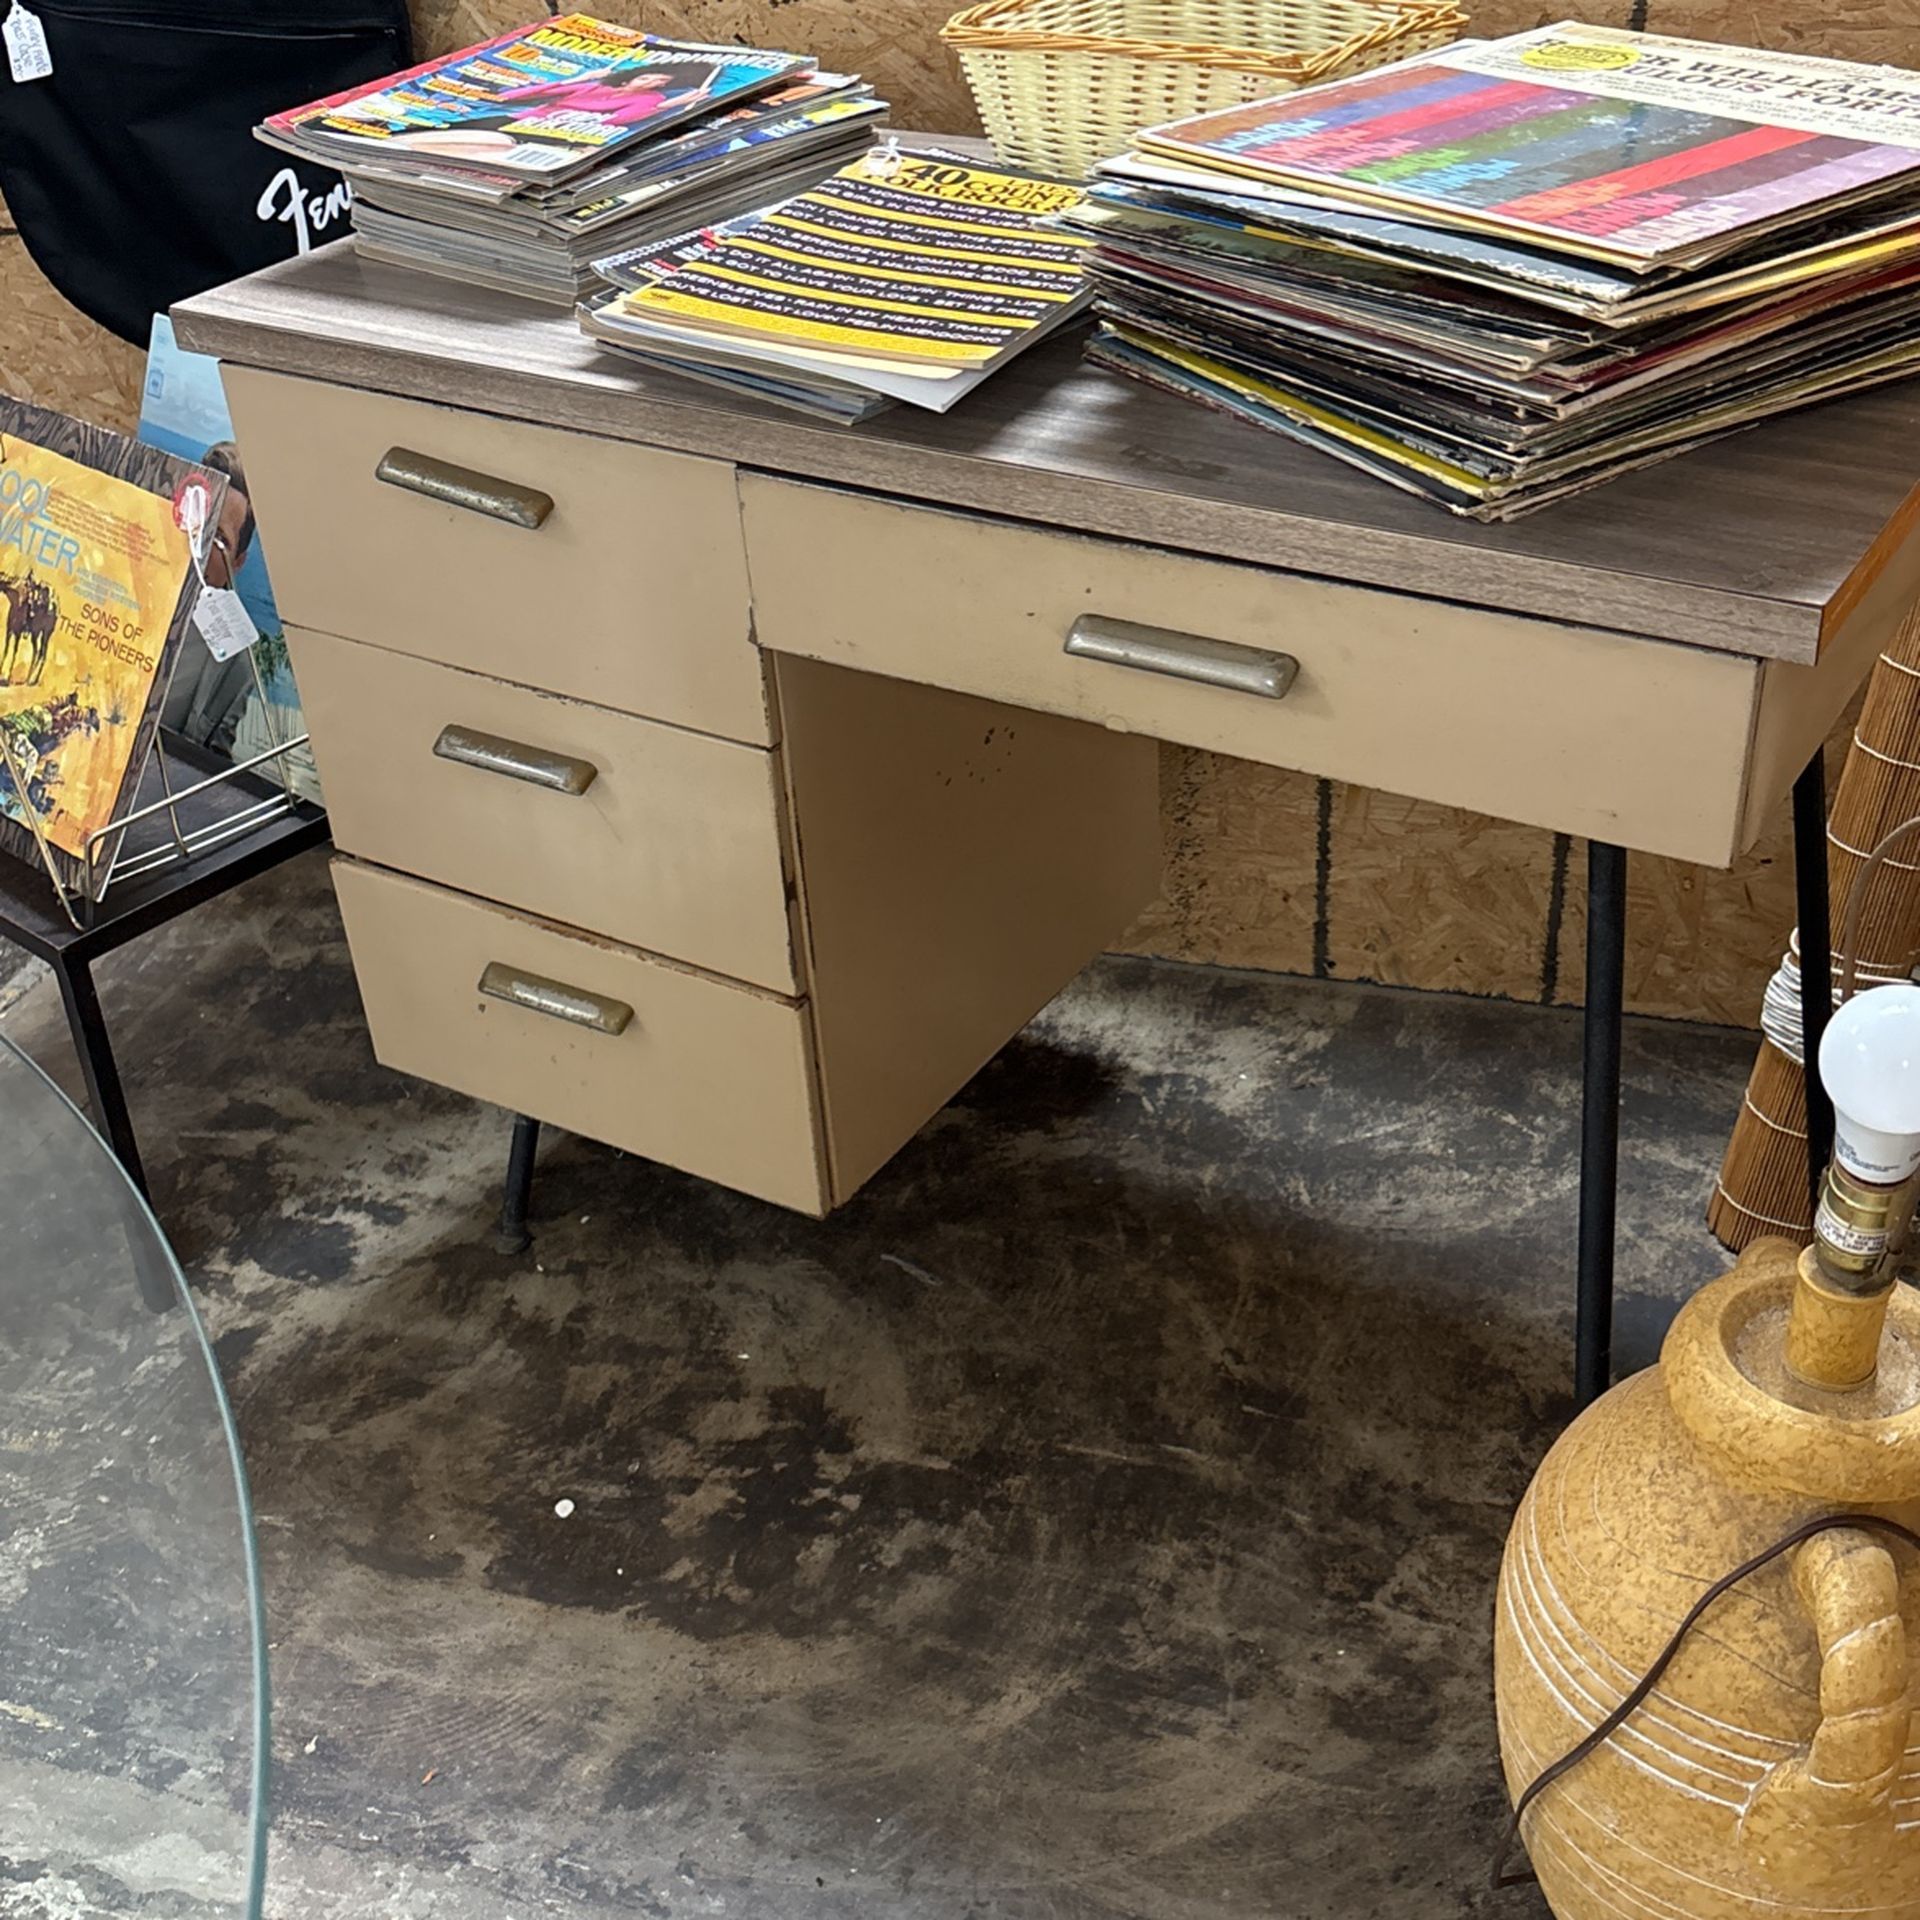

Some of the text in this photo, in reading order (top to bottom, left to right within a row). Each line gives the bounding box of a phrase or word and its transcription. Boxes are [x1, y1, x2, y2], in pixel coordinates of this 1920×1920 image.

[529, 27, 651, 61] MODERN
[864, 175, 947, 197] OLK,
[950, 188, 1038, 211] ROCK
[901, 163, 1079, 195] 40 LATES
[963, 179, 1087, 205] COUNT
[842, 191, 885, 208] GIRLS
[888, 201, 901, 211] IN
[904, 204, 977, 222] COUNTRY
[978, 217, 1027, 230] MUSIC
[868, 187, 937, 207] MORNING
[945, 201, 988, 216] BLUES
[989, 209, 1023, 221] AND
[781, 208, 814, 220] GOT
[828, 220, 862, 232] LINE
[863, 227, 887, 237] ON
[891, 232, 923, 243] YOU
[935, 239, 997, 253] WOMAN
[1000, 247, 1067, 262] HELPING
[826, 210, 888, 228] CHANGE
[890, 222, 913, 232] MY
[959, 233, 988, 244] THE
[990, 238, 1073, 252] GREATEST
[729, 249, 753, 260] DO
[755, 256, 772, 264] IT
[770, 260, 797, 272] ALL
[800, 267, 850, 282] AGAIN
[858, 277, 891, 288] THE
[945, 290, 1005, 305] THINGS
[1014, 299, 1049, 309] LIFE
[770, 236, 802, 249] HER
[868, 257, 880, 266] A
[886, 260, 975, 279] MILLIONAIRE
[980, 273, 1075, 292] GALVESTON
[790, 232, 871, 254] SERENADE
[875, 250, 901, 259] MY
[904, 253, 980, 269] WOMAN'S
[981, 263, 1030, 277] GOOD
[1034, 268, 1058, 280] TO
[1059, 274, 1084, 284] ME
[725, 258, 761, 273] GOT
[762, 268, 783, 278] TO
[784, 274, 829, 288] HAVE
[832, 283, 876, 297] YOUR
[878, 290, 922, 303] LOVE
[933, 299, 964, 308] SET
[968, 302, 993, 312] ME
[996, 307, 1039, 318] FREE
[710, 290, 752, 307] LOST
[753, 299, 796, 314] THAT
[902, 325, 1002, 344] MENDOCINO
[795, 297, 834, 311] RAIN
[834, 305, 852, 315] IN
[854, 309, 880, 318] MY
[882, 313, 939, 327] HEART
[947, 322, 1013, 336] TRACES
[0, 469, 52, 523] OOL
[59, 614, 155, 673] THE PIONEERS
[81, 603, 144, 642] SONS OF
